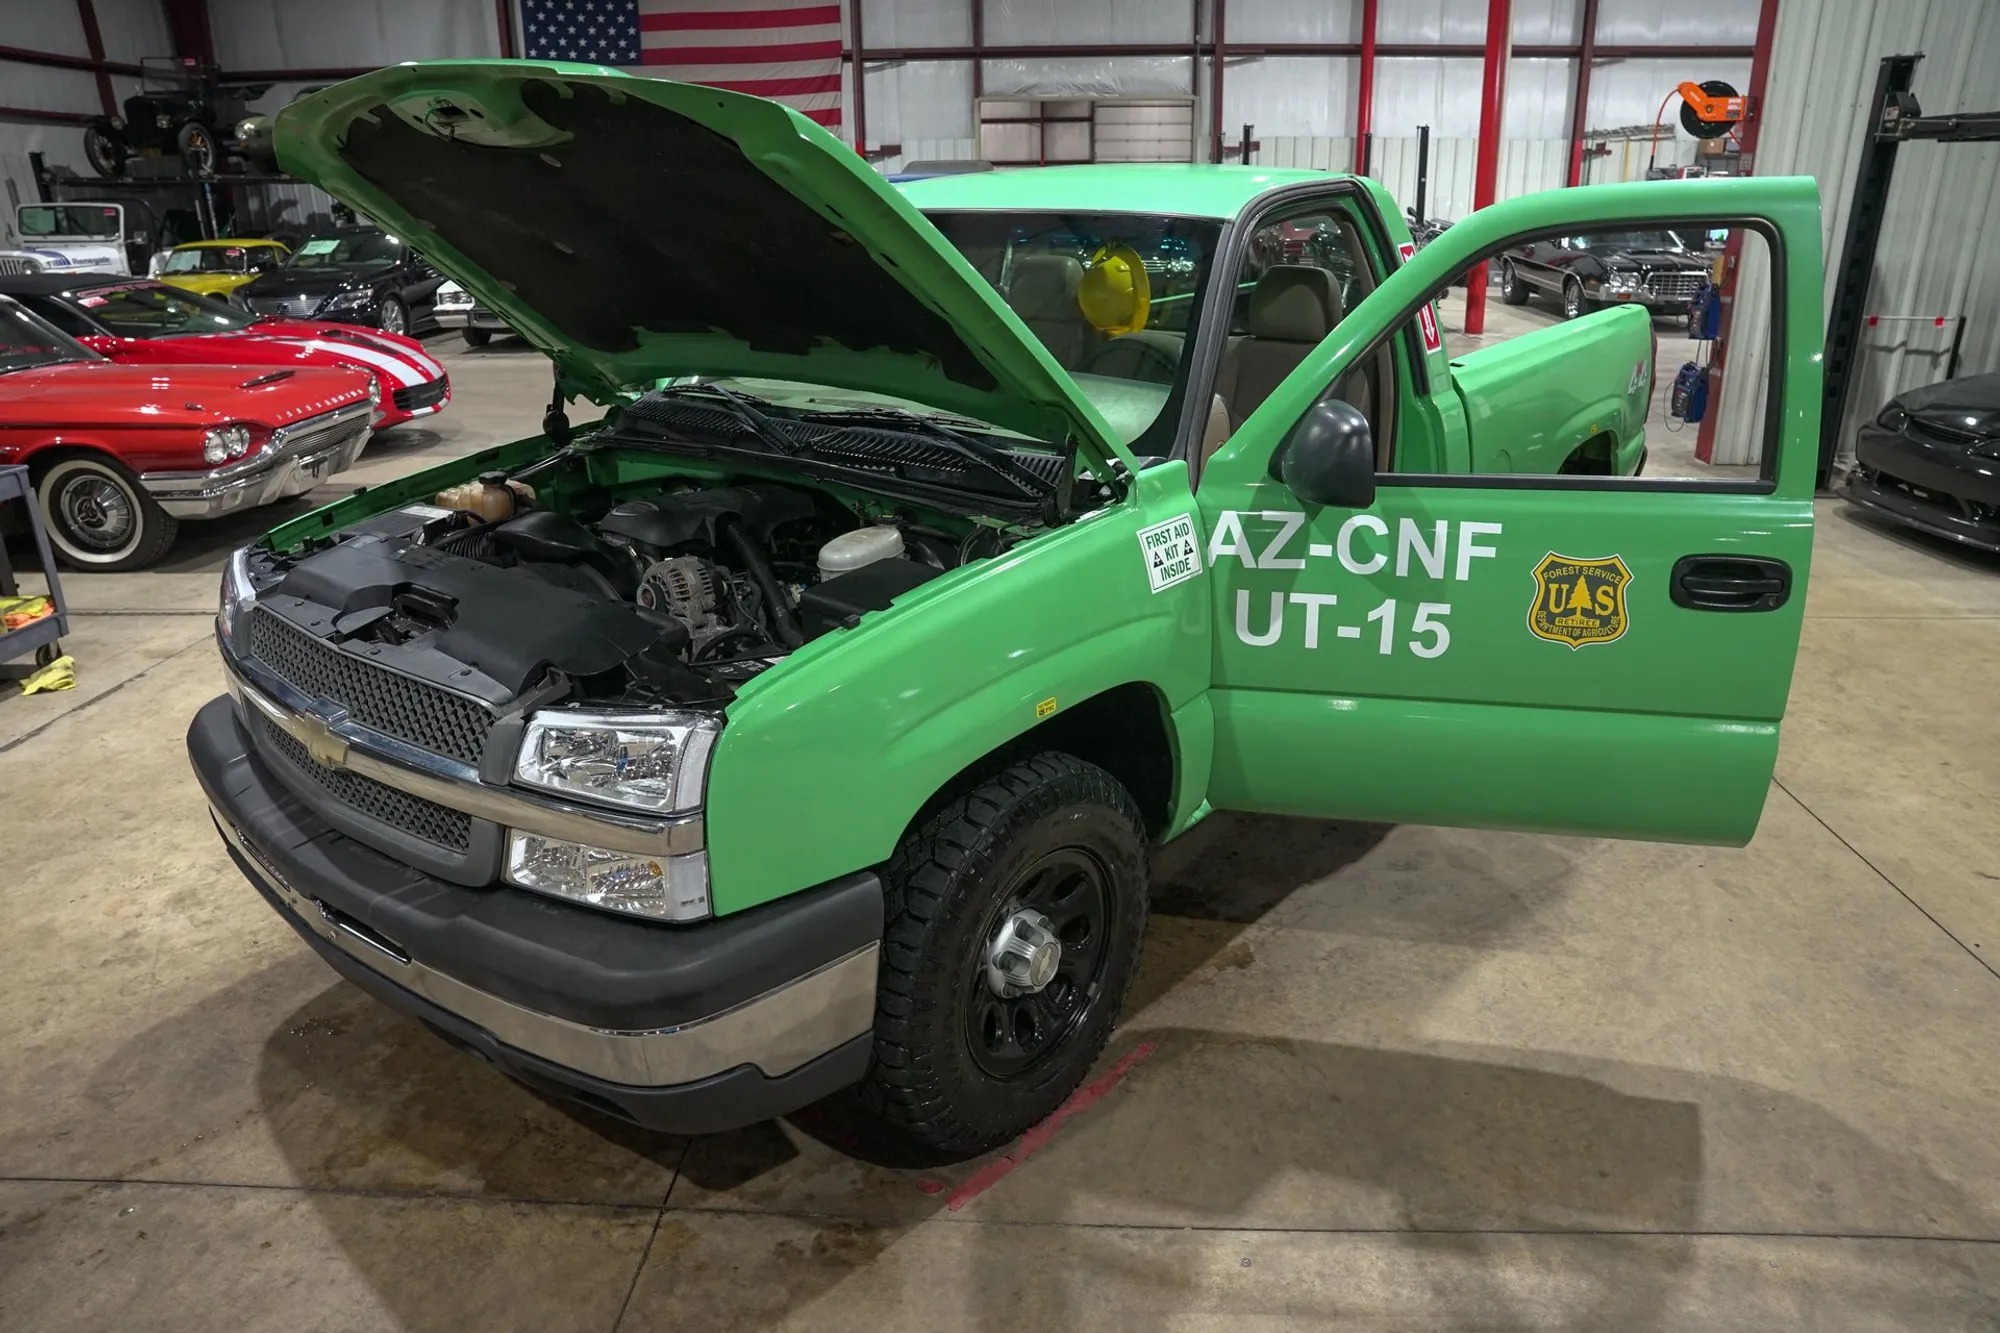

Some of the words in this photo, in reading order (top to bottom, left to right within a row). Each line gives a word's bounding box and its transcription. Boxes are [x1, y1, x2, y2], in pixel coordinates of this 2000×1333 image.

[1145, 528, 1172, 550] FIRST
[1174, 522, 1190, 540] AID
[1208, 510, 1503, 581] AZ-CNF
[1164, 544, 1179, 561] KIT
[1160, 557, 1191, 582] INSIDE
[1543, 566, 1580, 581] FOREST
[1582, 566, 1622, 585] SERVICE
[1235, 589, 1452, 659] UT-15
[1557, 618, 1598, 627] RETIREE
[1572, 627, 1581, 637] OF
[1582, 615, 1620, 637] AGRICULTURE
